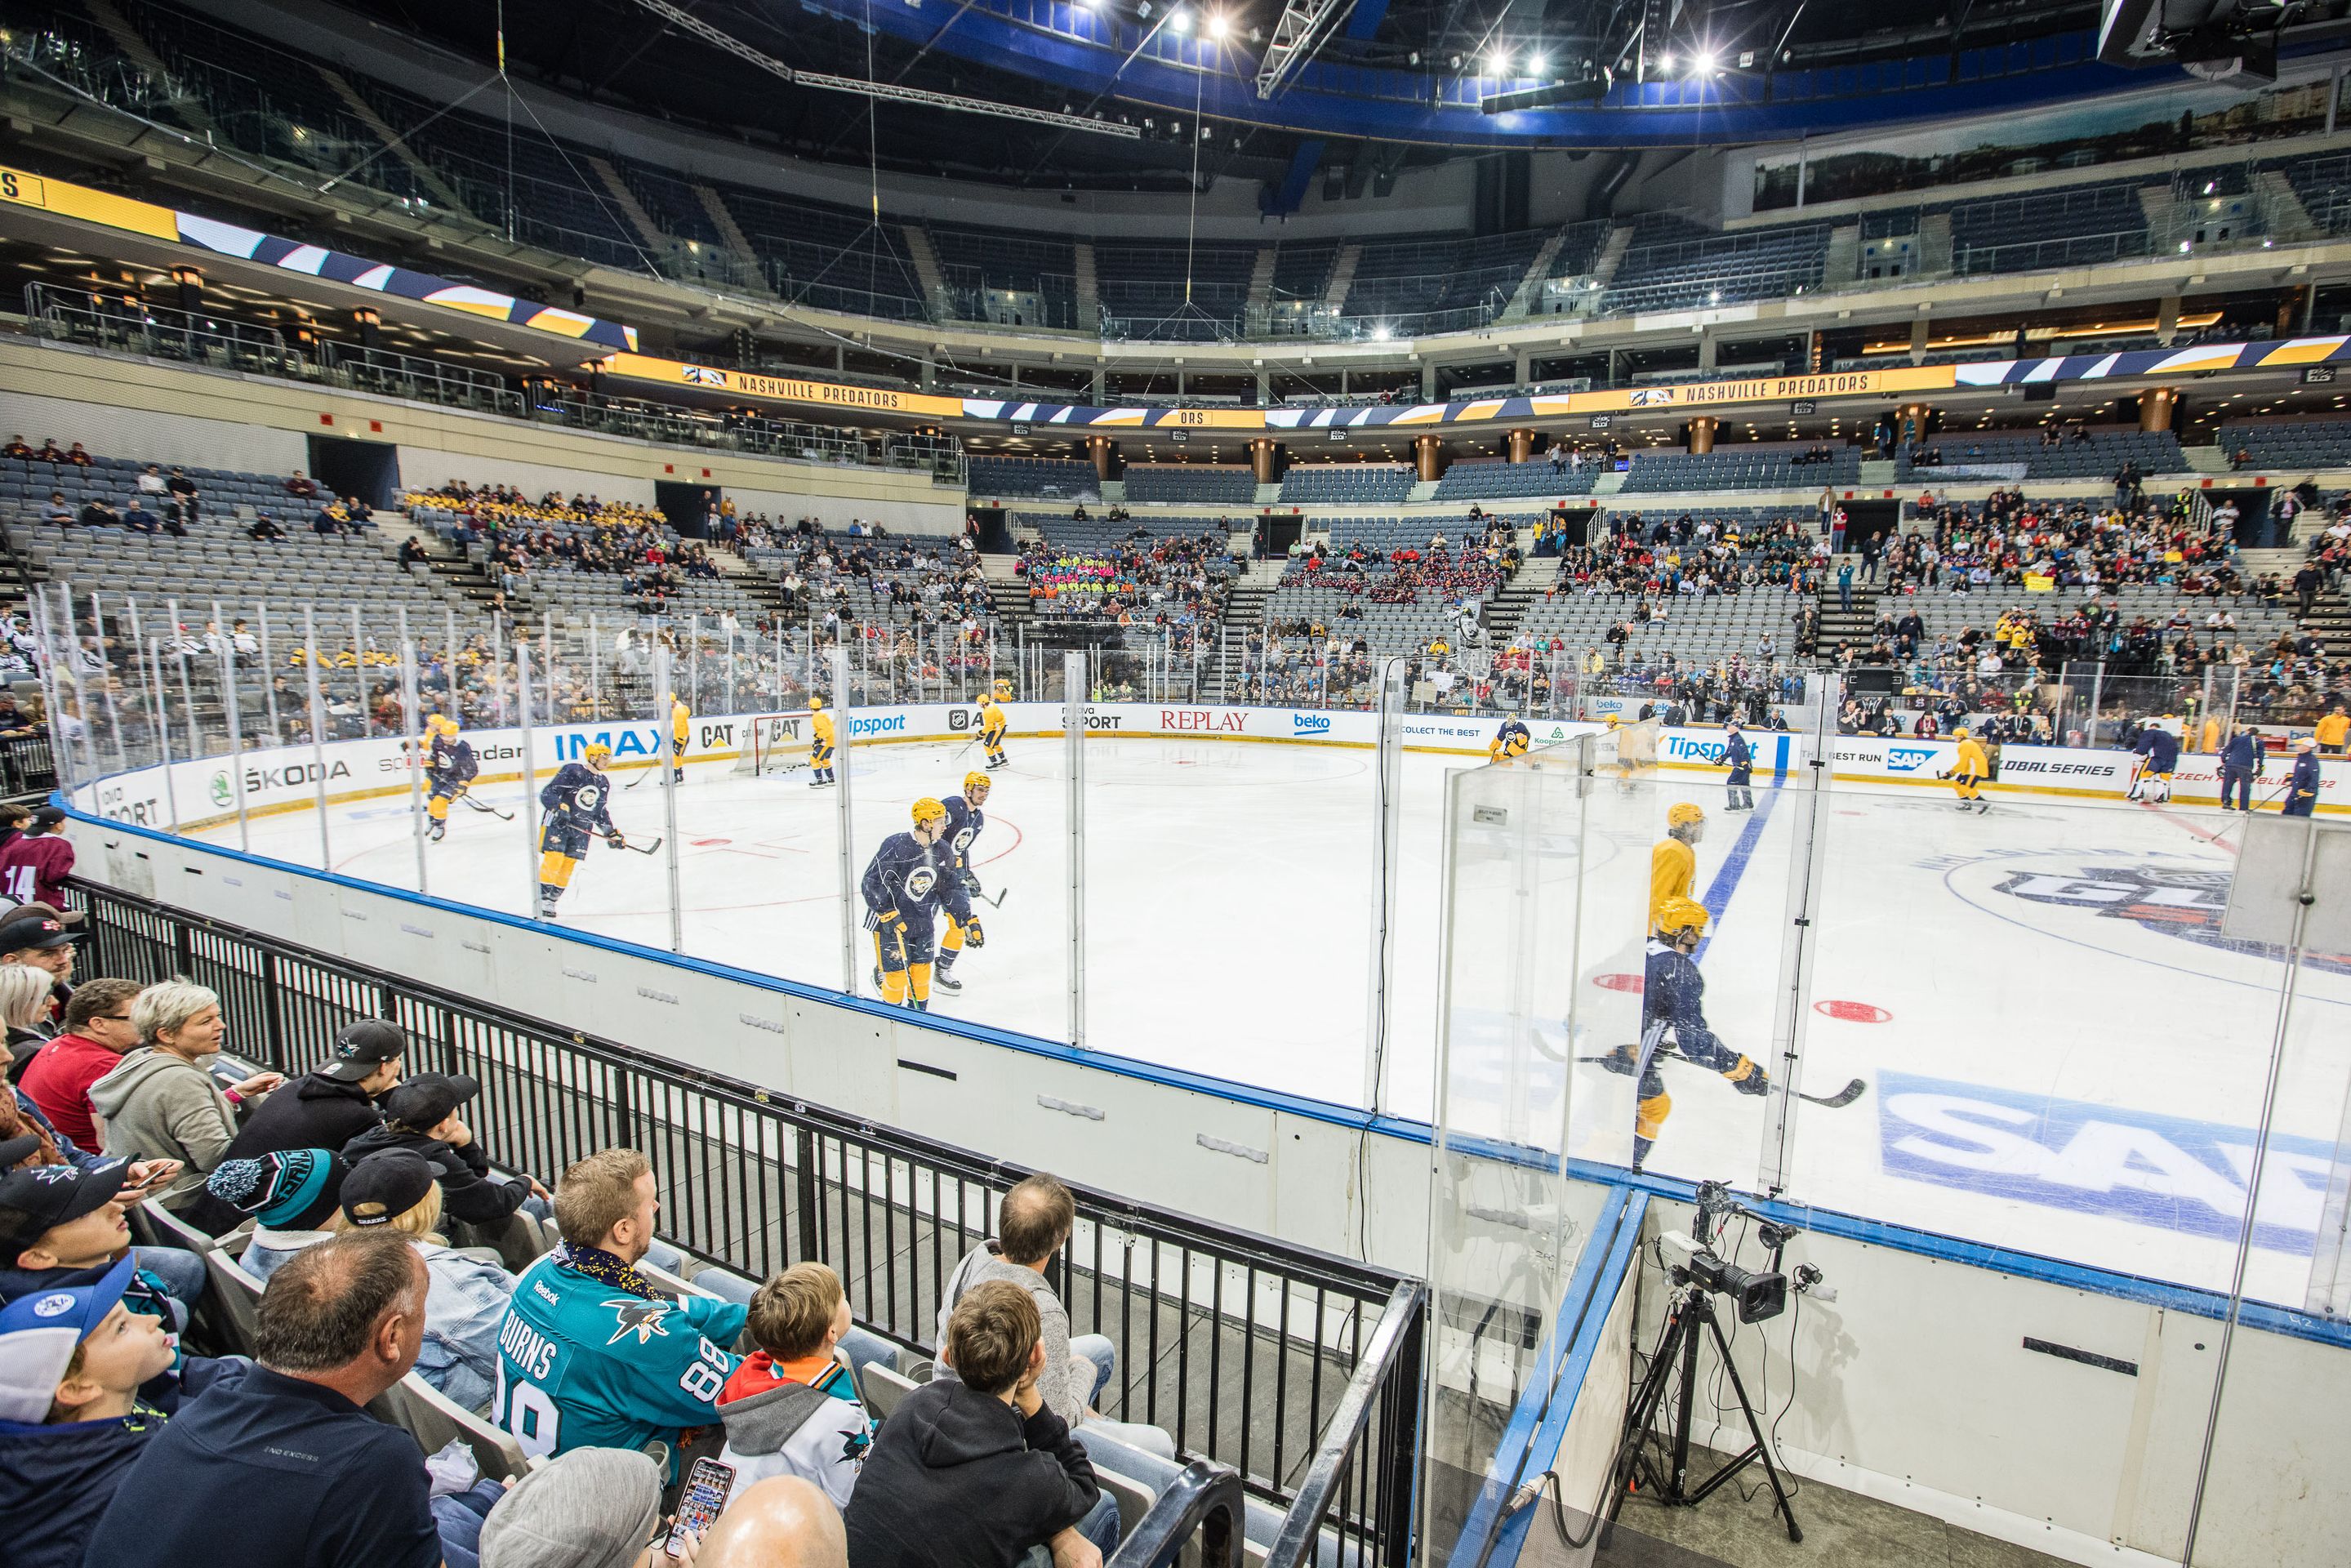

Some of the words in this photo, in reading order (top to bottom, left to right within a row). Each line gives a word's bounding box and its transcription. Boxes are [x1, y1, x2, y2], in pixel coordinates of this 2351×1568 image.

[740, 376, 813, 398] NASHVILLE
[823, 387, 898, 408] PREDATORS
[1686, 381, 1766, 401] NASHVILLE
[1778, 375, 1868, 394] PREDATORS
[1181, 412, 1204, 424] ORS
[848, 715, 906, 737] ipsport
[1160, 710, 1249, 732] REPLAY
[1294, 713, 1331, 729] beko
[1438, 728, 1454, 736] THE
[1457, 728, 1481, 737] BEST
[701, 723, 733, 748] CAT
[1668, 737, 1758, 760] Tipspt
[1859, 754, 1882, 763] RUN
[1889, 751, 1926, 768] SAP
[245, 760, 351, 793] ŠKODA
[5, 866, 37, 904] 14
[358, 1216, 387, 1225] SHARKS
[533, 1279, 561, 1307] Reebok
[499, 1307, 559, 1381] BURNS
[679, 1334, 730, 1403] 88
